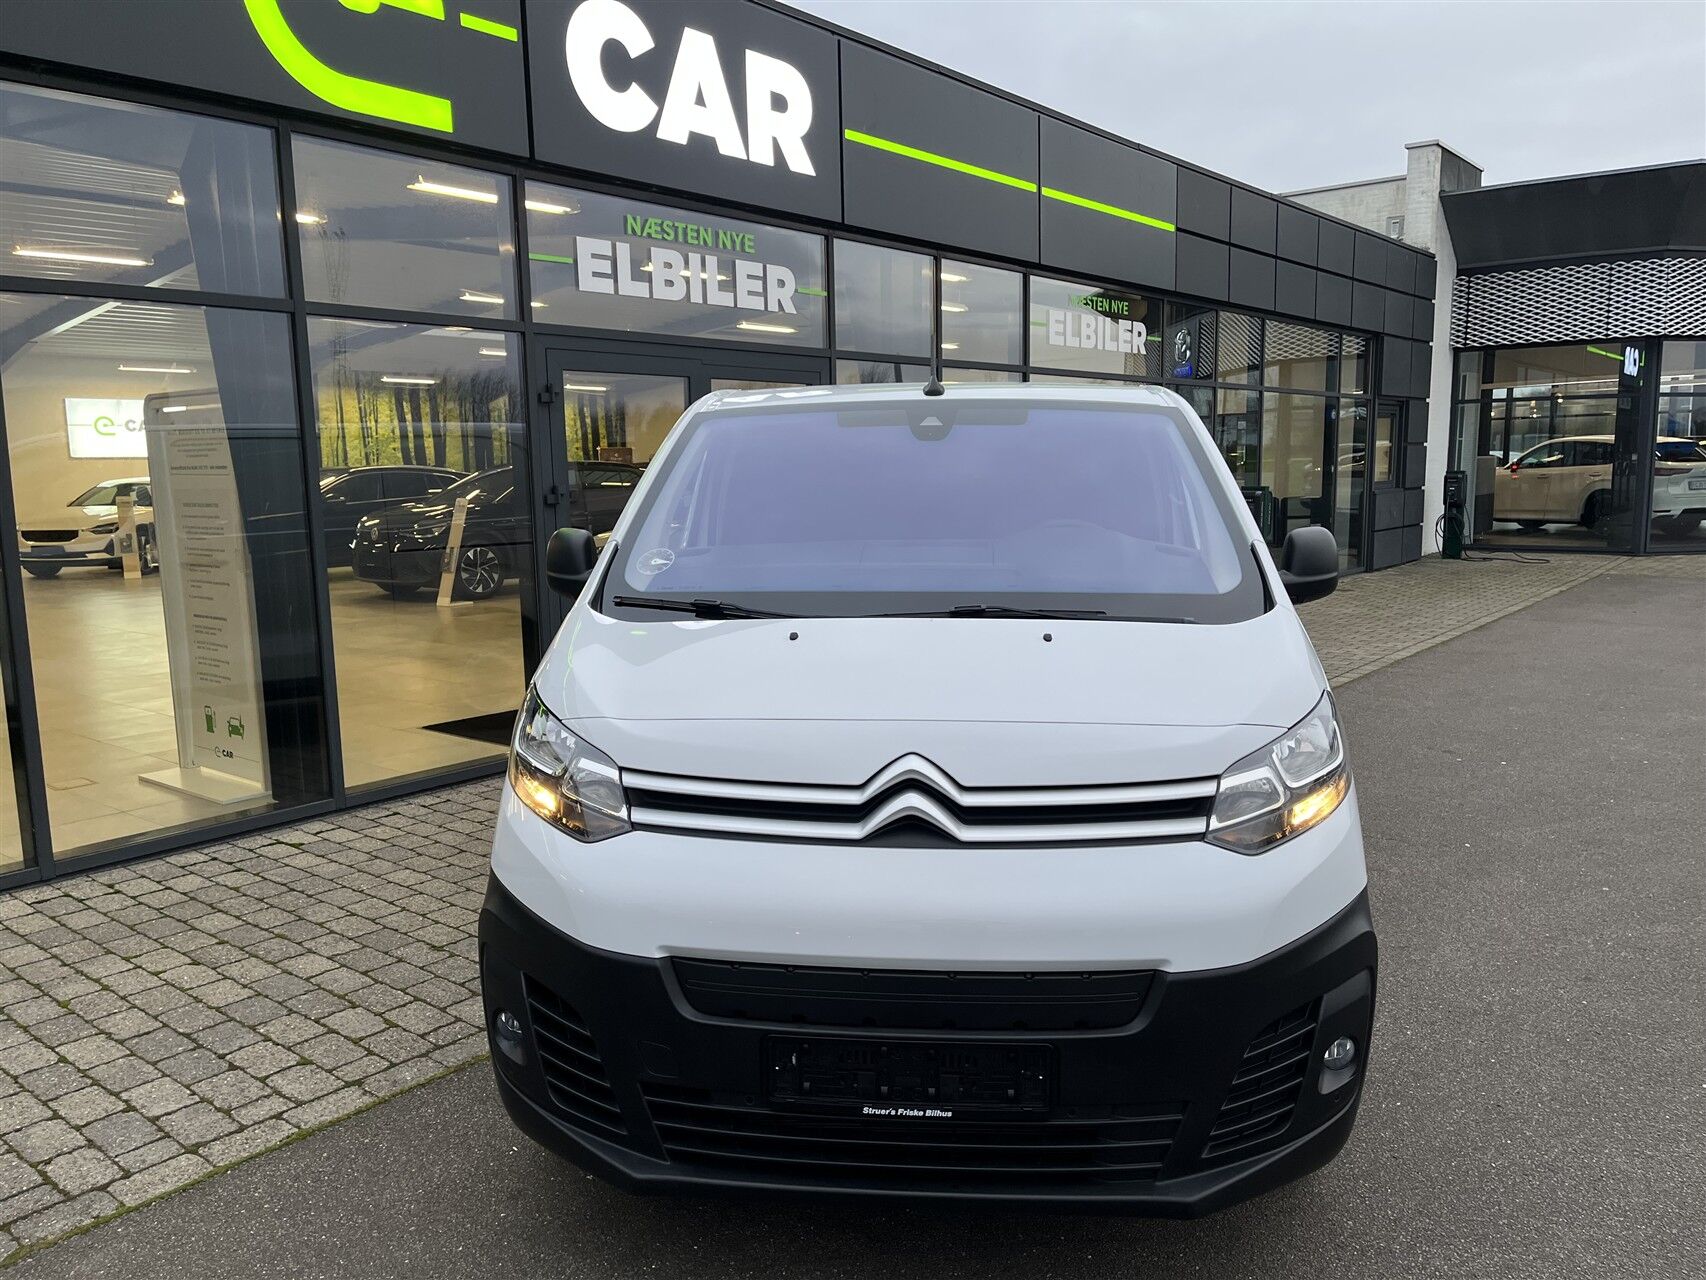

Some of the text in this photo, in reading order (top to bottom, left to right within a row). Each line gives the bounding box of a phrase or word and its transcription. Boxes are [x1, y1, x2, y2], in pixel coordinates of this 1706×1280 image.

[566, 0, 816, 176] CAR
[626, 213, 755, 254] NÆSTEN NYE
[576, 236, 797, 314] ELBILER
[1111, 299, 1129, 315] NYE
[1049, 309, 1147, 354] ELBILER
[222, 749, 234, 758] CAR
[862, 1106, 953, 1117] Struer's Friske Bilhus
